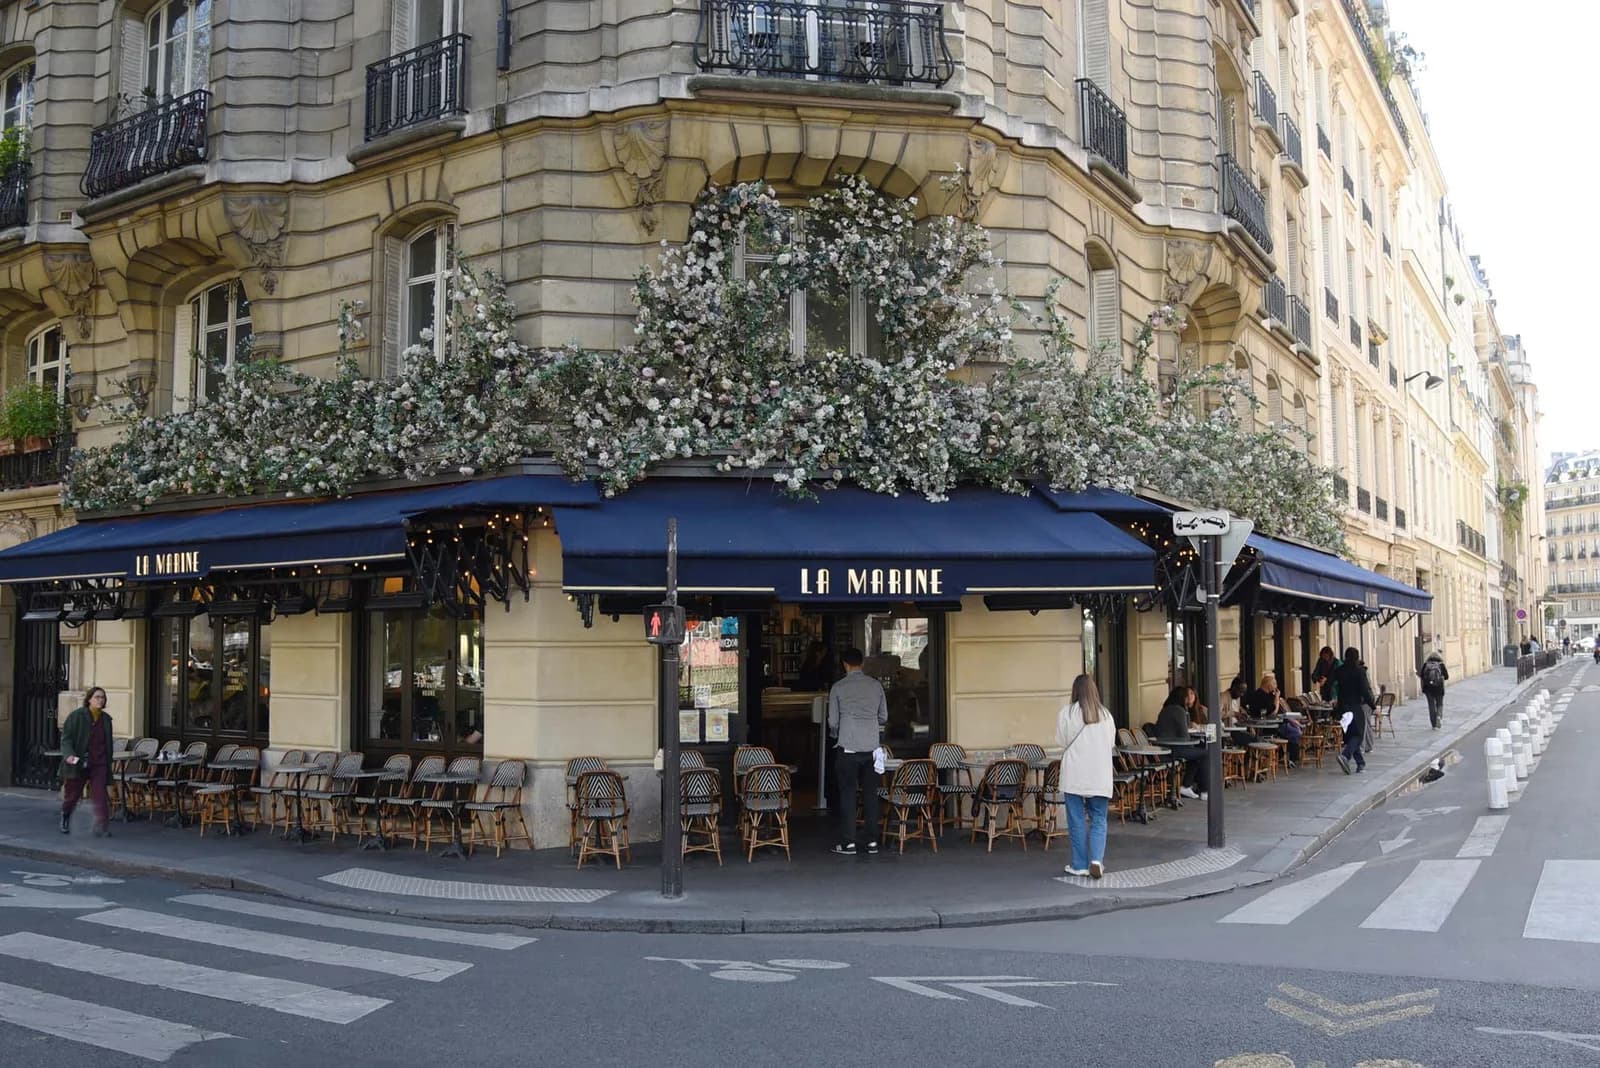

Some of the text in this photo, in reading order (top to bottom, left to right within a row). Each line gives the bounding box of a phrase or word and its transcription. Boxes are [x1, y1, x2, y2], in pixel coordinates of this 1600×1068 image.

[136, 551, 199, 576] LA MARINE
[801, 568, 943, 594] LA MARINE
